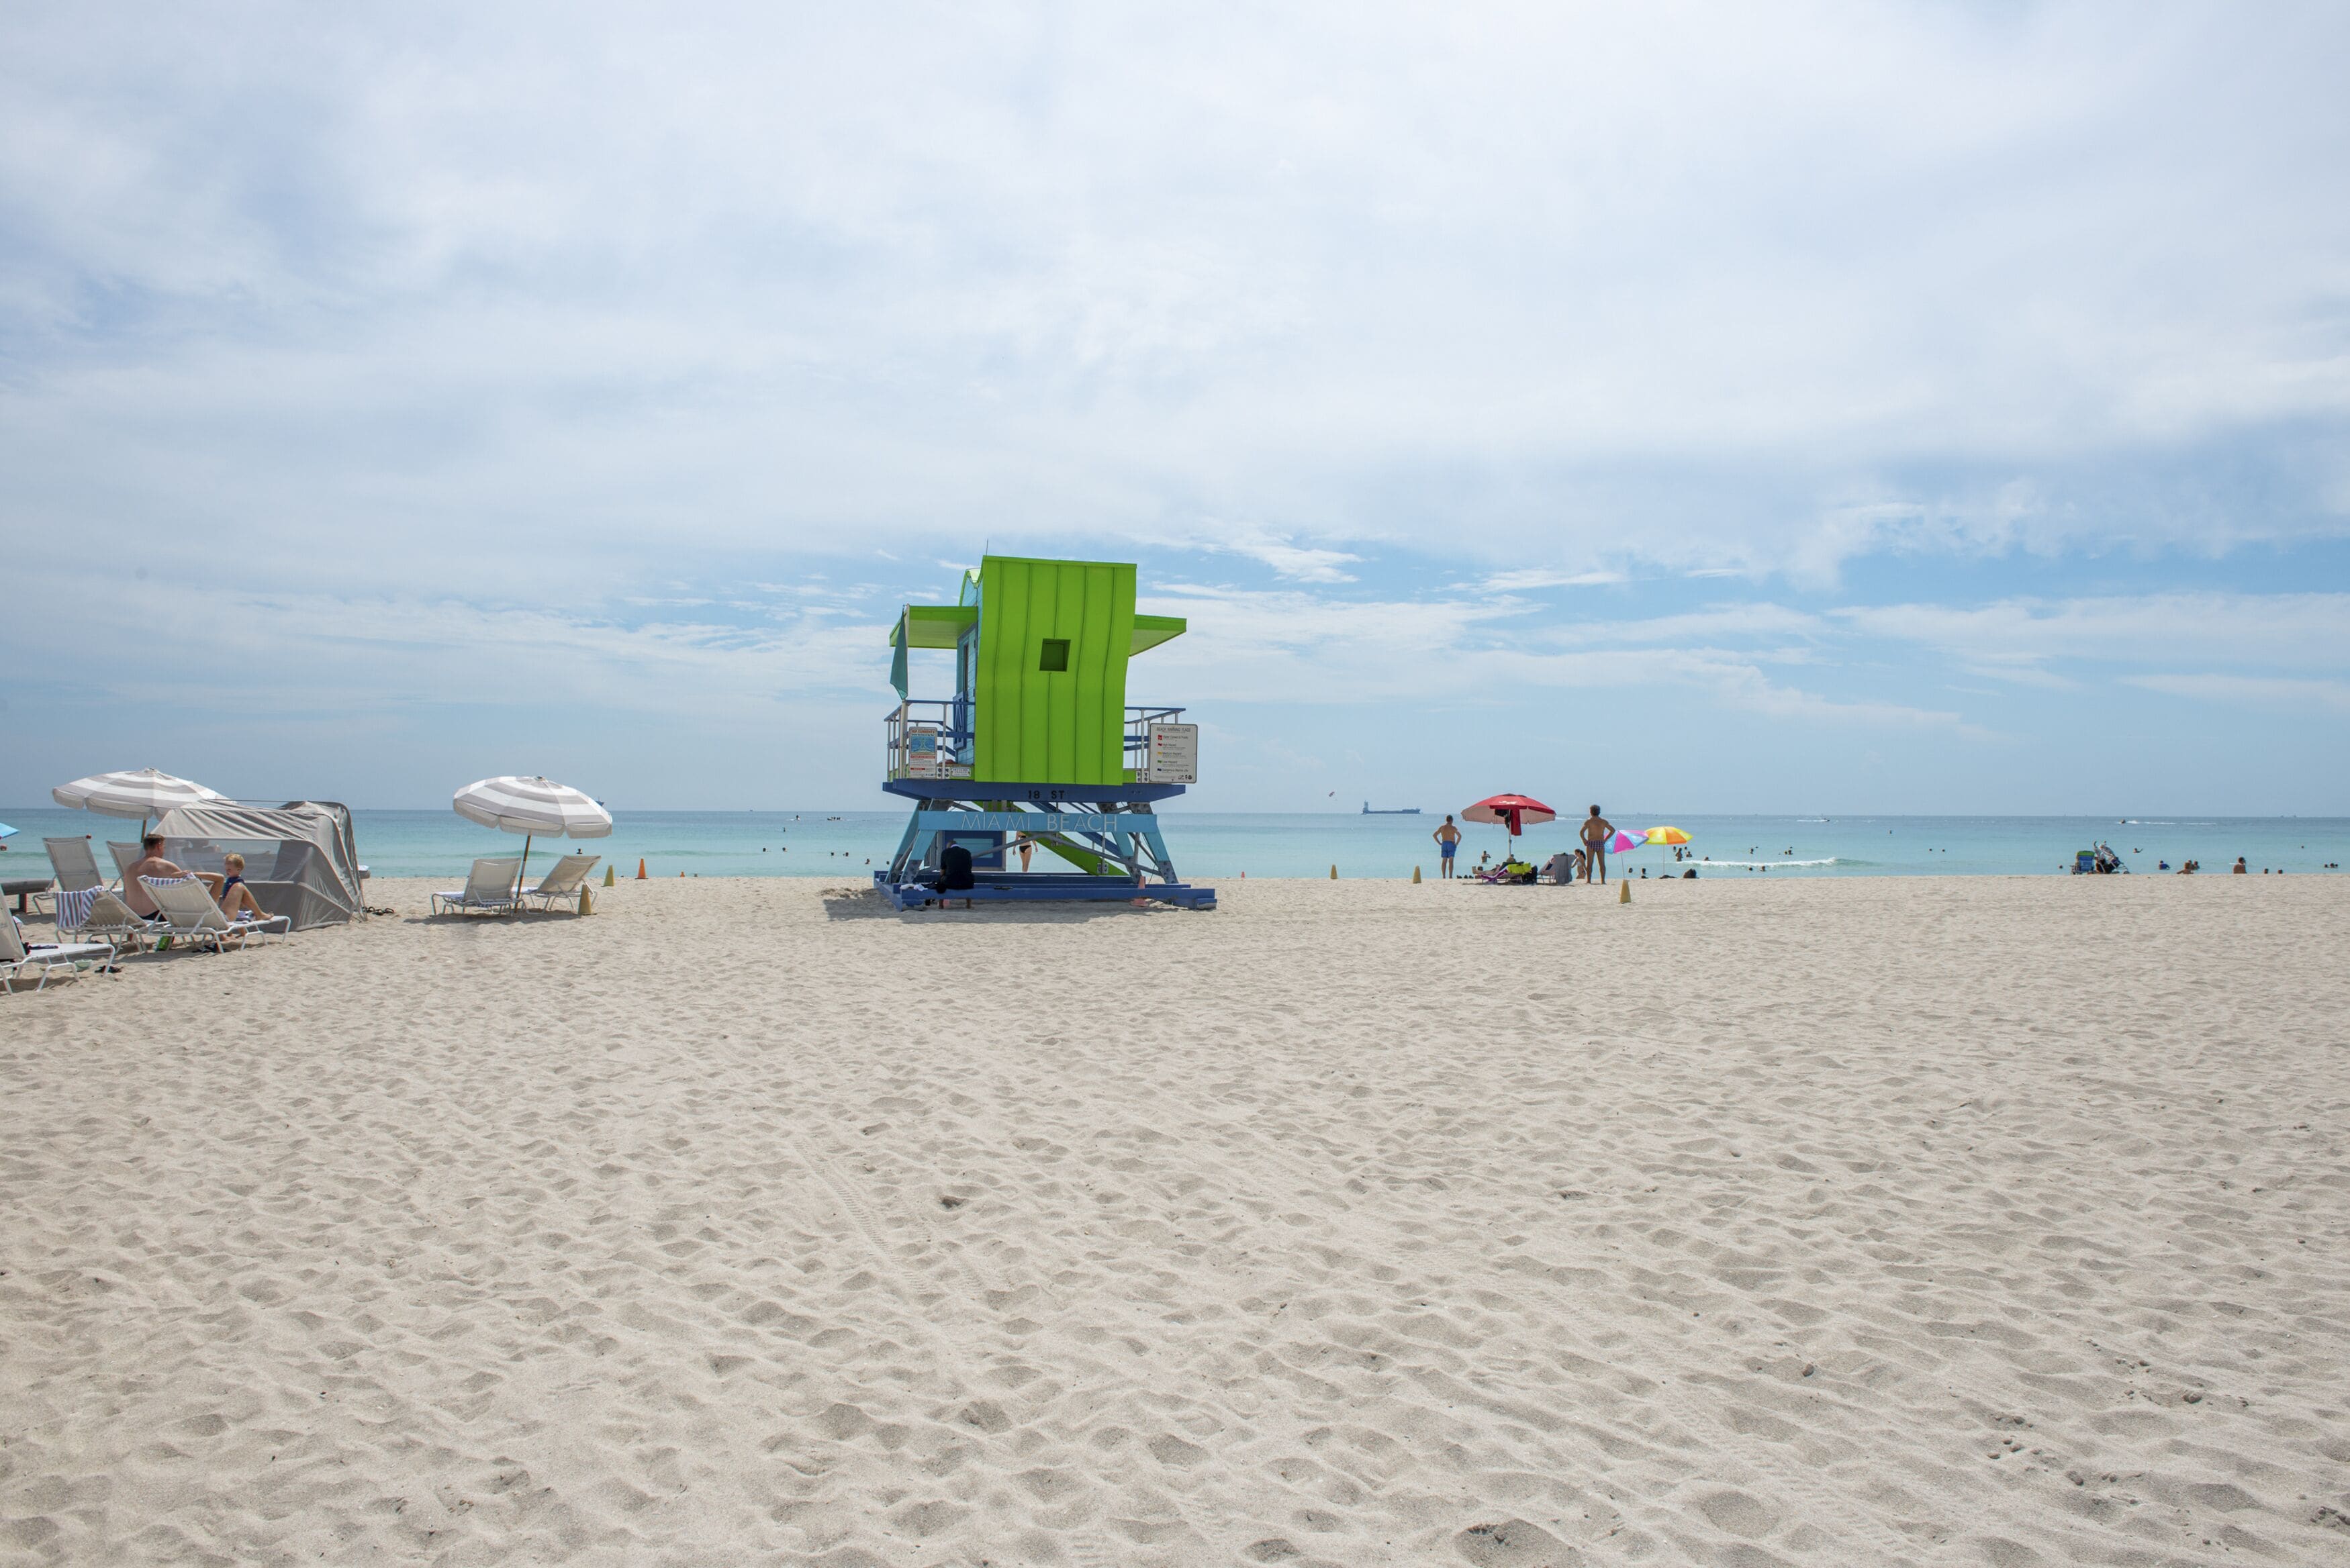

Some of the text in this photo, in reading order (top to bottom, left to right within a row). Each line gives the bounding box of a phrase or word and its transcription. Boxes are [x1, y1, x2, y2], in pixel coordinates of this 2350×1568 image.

[1029, 790, 1065, 799] 18 ST
[961, 812, 1117, 832] MIAMI BEACH
